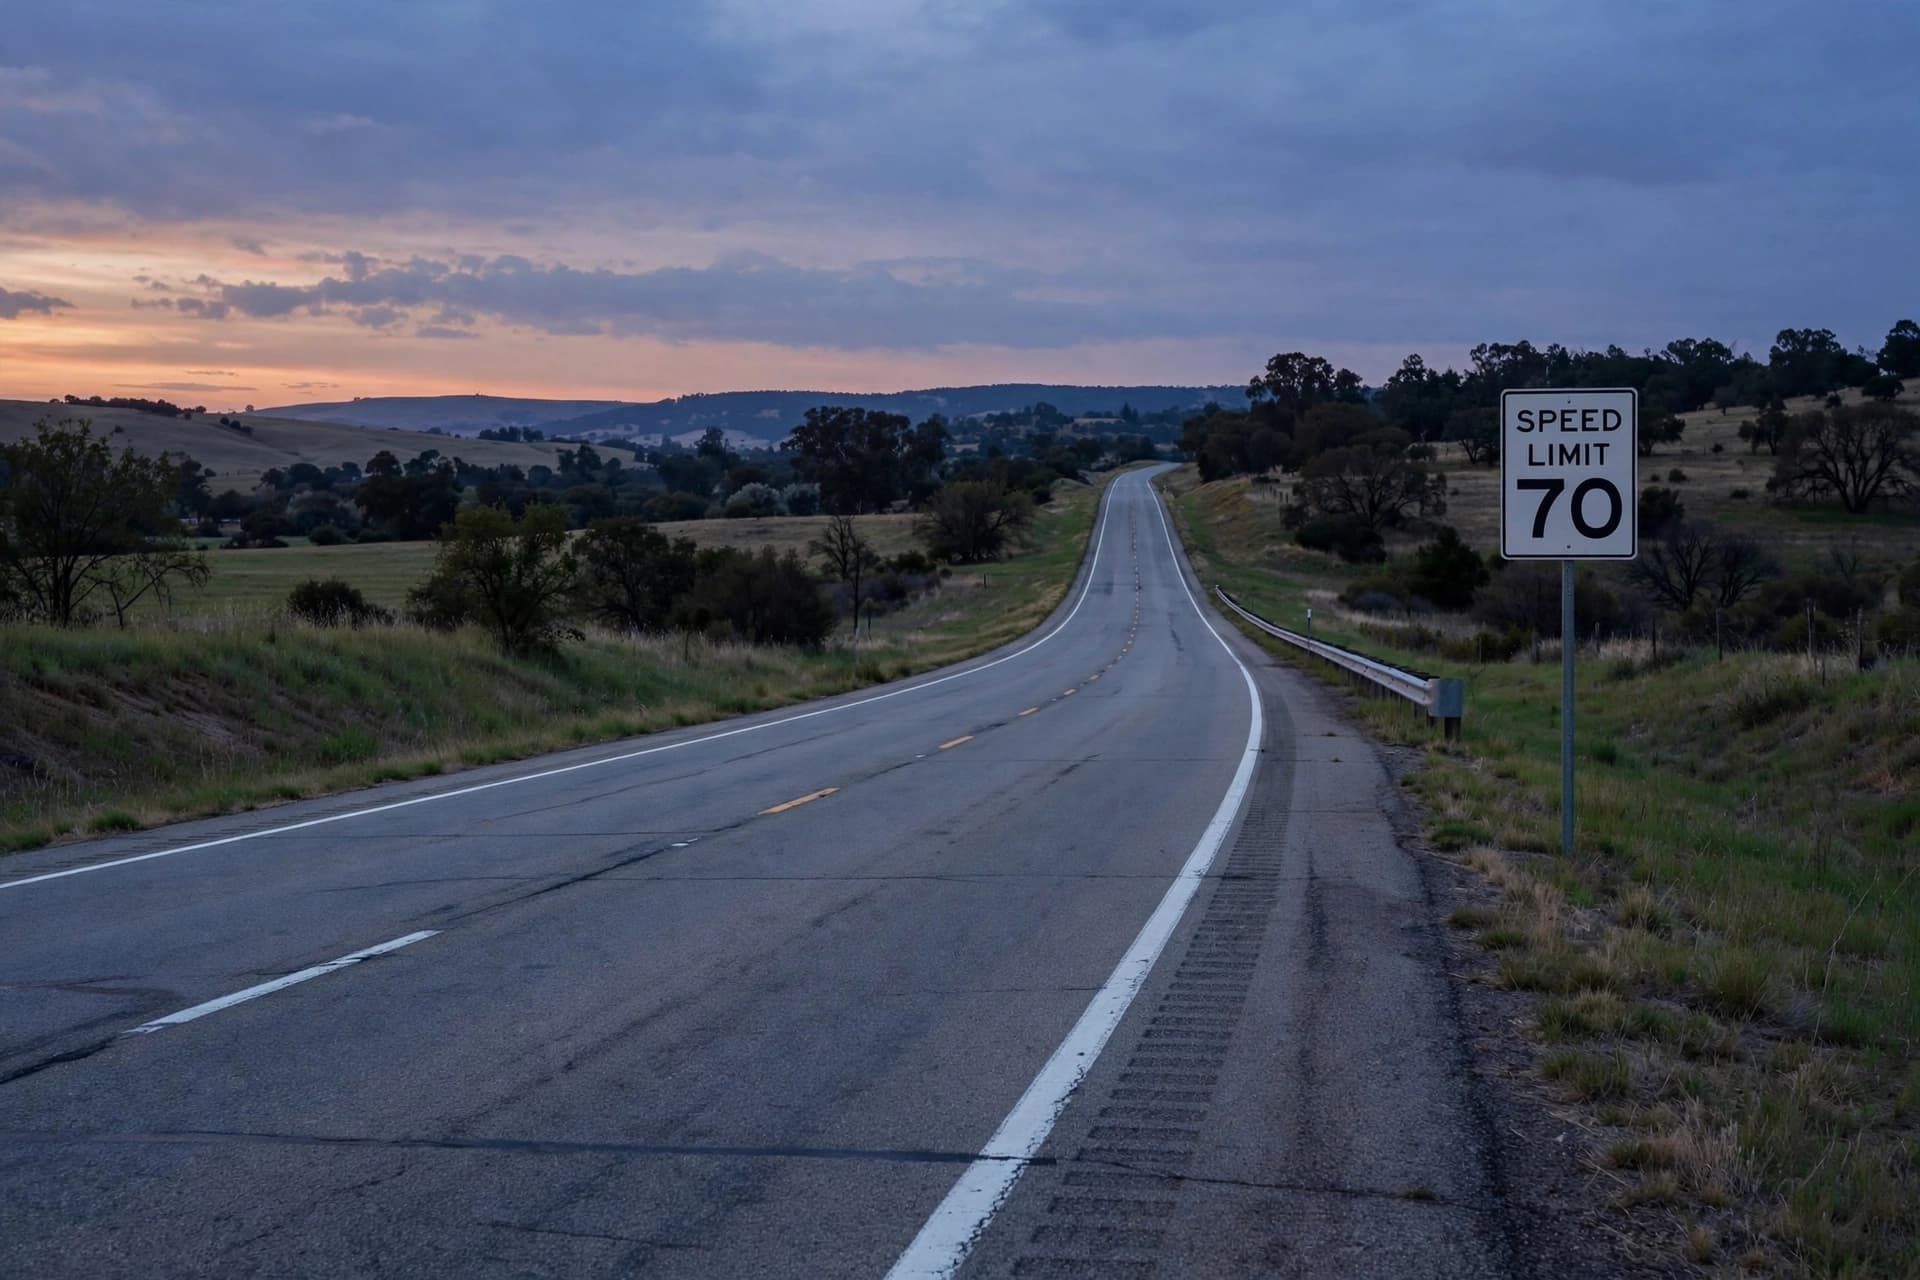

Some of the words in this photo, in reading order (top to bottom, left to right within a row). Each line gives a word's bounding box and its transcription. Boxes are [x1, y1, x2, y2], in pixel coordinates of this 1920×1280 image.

[1516, 409, 1622, 433] SPEED
[1528, 443, 1610, 466] LIMIT
[1517, 478, 1622, 539] 70
